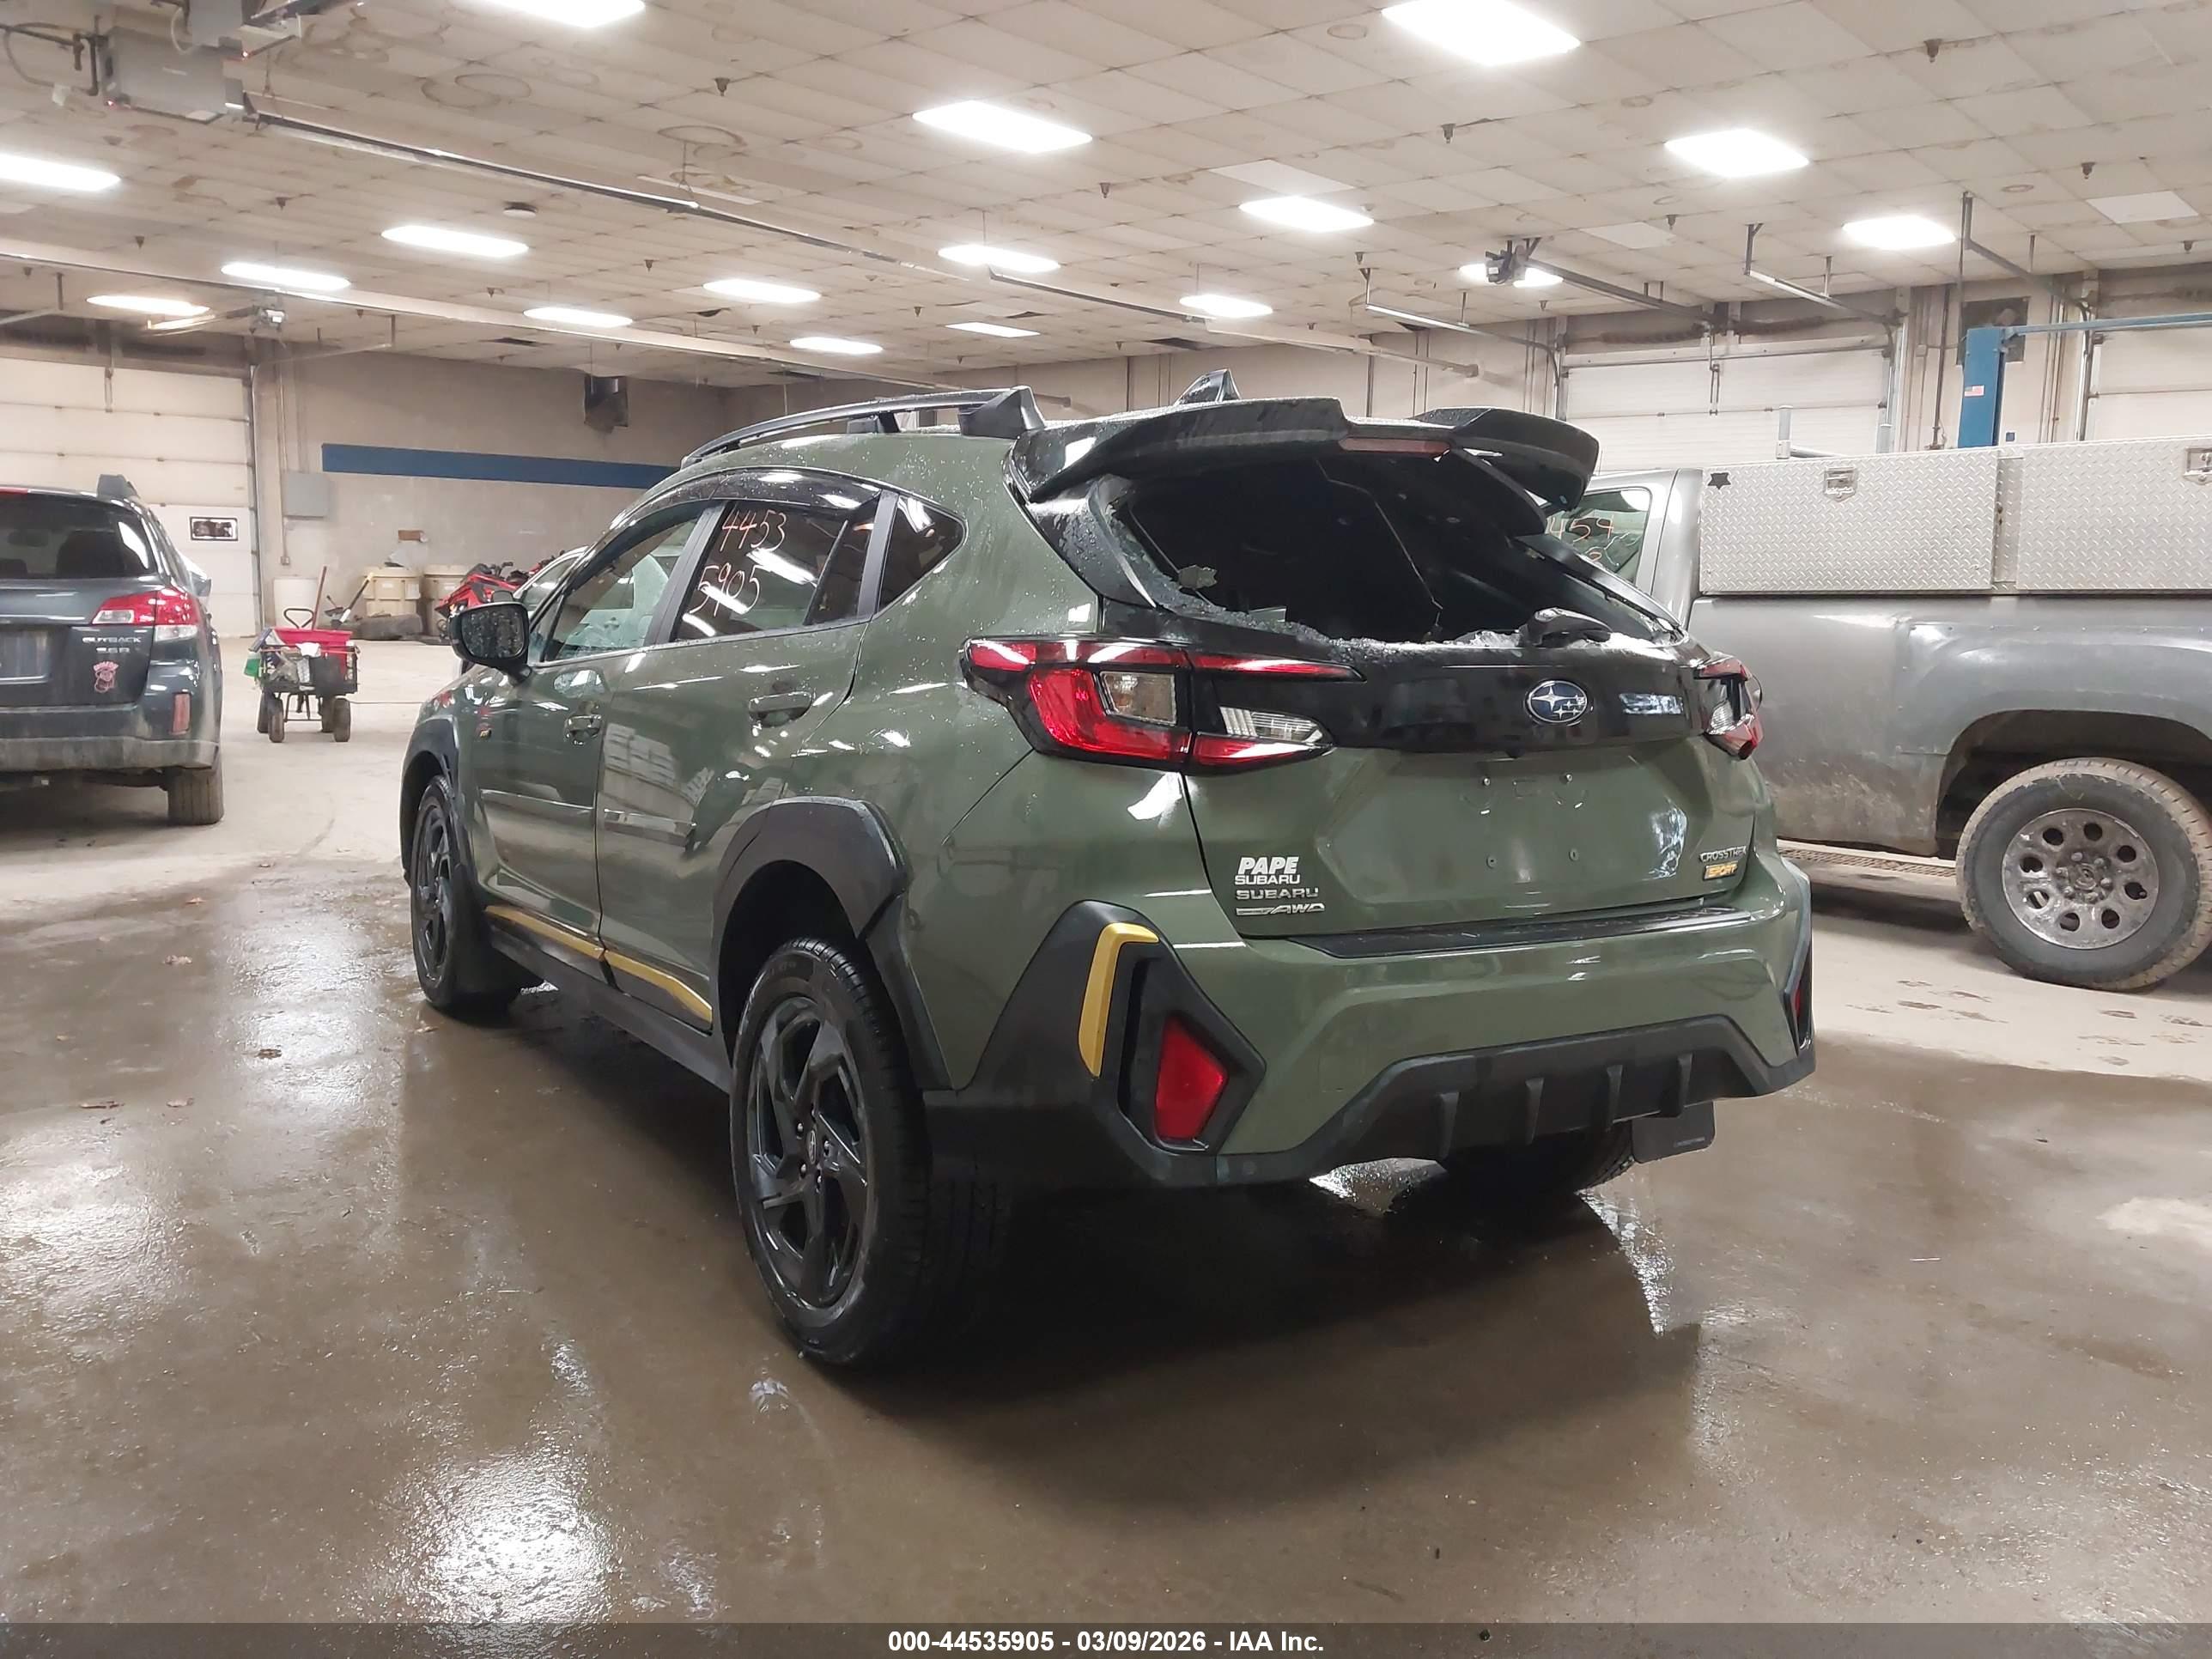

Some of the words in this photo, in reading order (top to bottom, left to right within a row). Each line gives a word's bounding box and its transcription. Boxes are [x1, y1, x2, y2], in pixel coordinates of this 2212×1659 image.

[720, 504, 787, 552] 4453
[689, 562, 764, 617] 5905
[1237, 856, 1299, 875] PAPE
[1235, 874, 1300, 885] SUBARU
[1237, 887, 1318, 900] SUBARU
